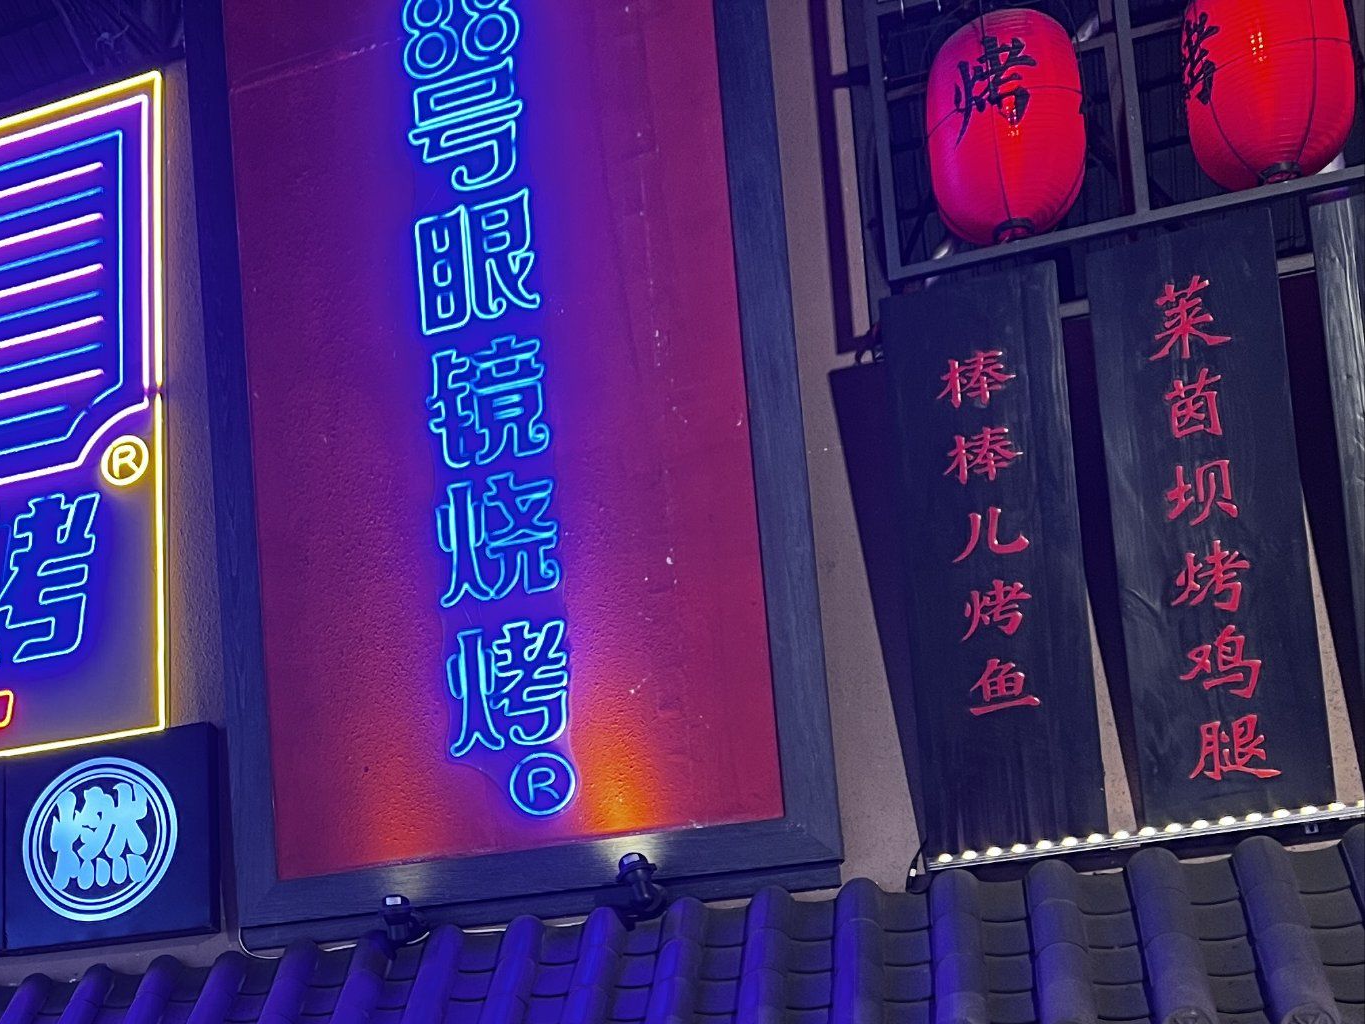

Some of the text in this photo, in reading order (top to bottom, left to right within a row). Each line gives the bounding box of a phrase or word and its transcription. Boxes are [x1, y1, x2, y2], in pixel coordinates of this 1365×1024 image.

[954, 36, 1037, 148] 烤
[937, 349, 1041, 718] 棒棒儿烤鱼
[1148, 274, 1283, 783] 莱茵坝烤鸡腿
[49, 782, 149, 892] 燃
